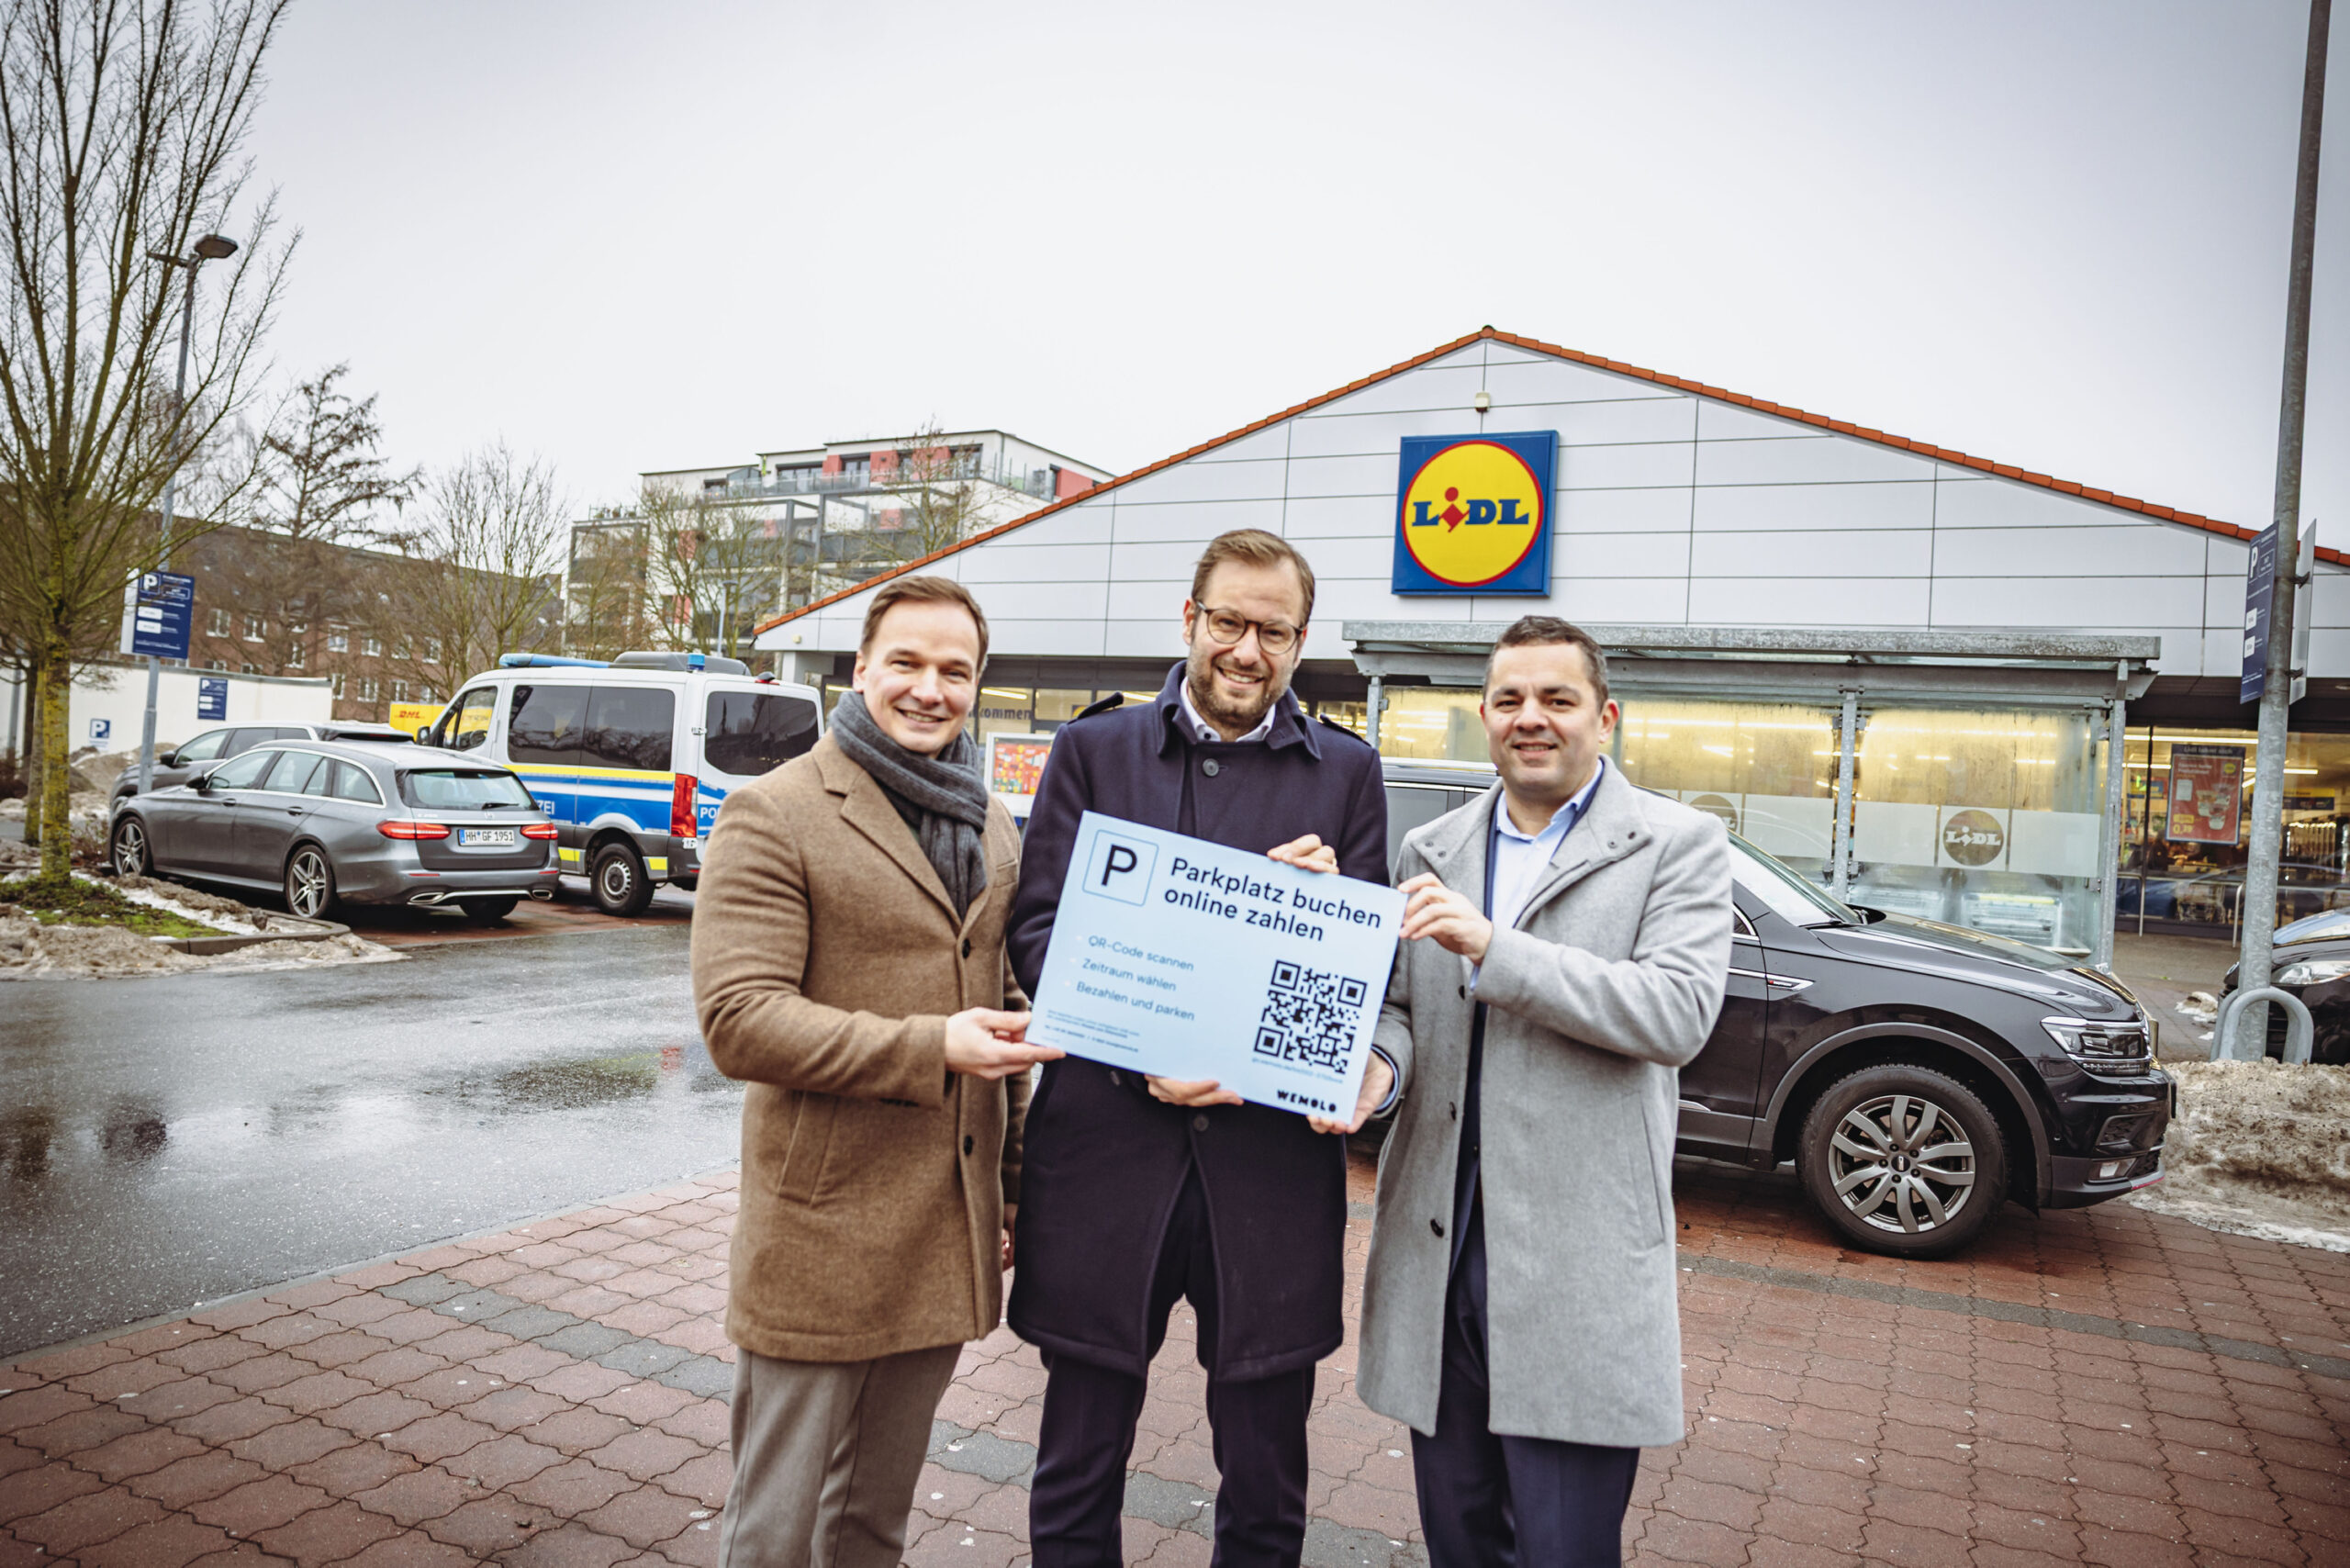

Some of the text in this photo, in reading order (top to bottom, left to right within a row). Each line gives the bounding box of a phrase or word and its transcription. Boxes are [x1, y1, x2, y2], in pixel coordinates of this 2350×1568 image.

[143, 573, 158, 590] P
[92, 721, 106, 738] P
[465, 831, 513, 842] HH GF 1951
[1101, 844, 1137, 887] P
[1170, 857, 1382, 928] Parkplatz buchen
[1164, 889, 1324, 942] online zahlen
[1088, 935, 1194, 971] QR-Code scannen
[1082, 958, 1177, 991] Zeitraum wählen
[1076, 980, 1195, 1021] Bezahlen und parken
[1277, 1090, 1337, 1113] WEMOLO
